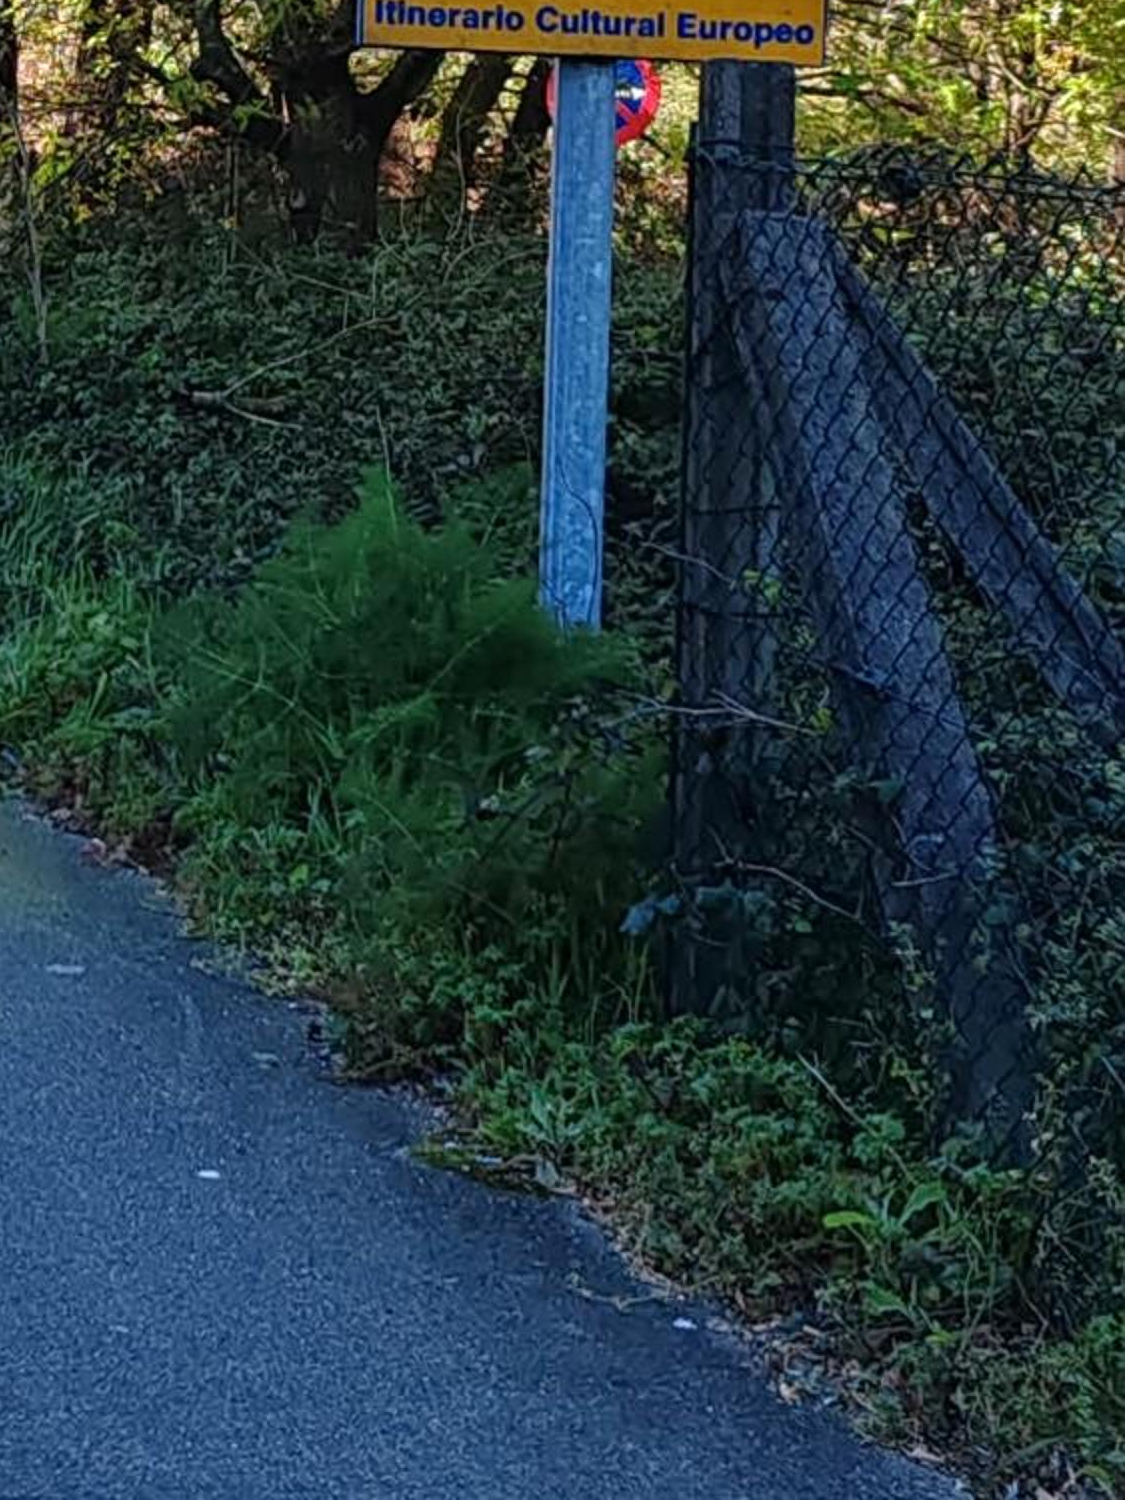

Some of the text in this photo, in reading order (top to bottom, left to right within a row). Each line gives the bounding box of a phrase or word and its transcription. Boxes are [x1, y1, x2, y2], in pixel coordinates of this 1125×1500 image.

[374, 0, 815, 49] Itinerario Cultural Europeo
